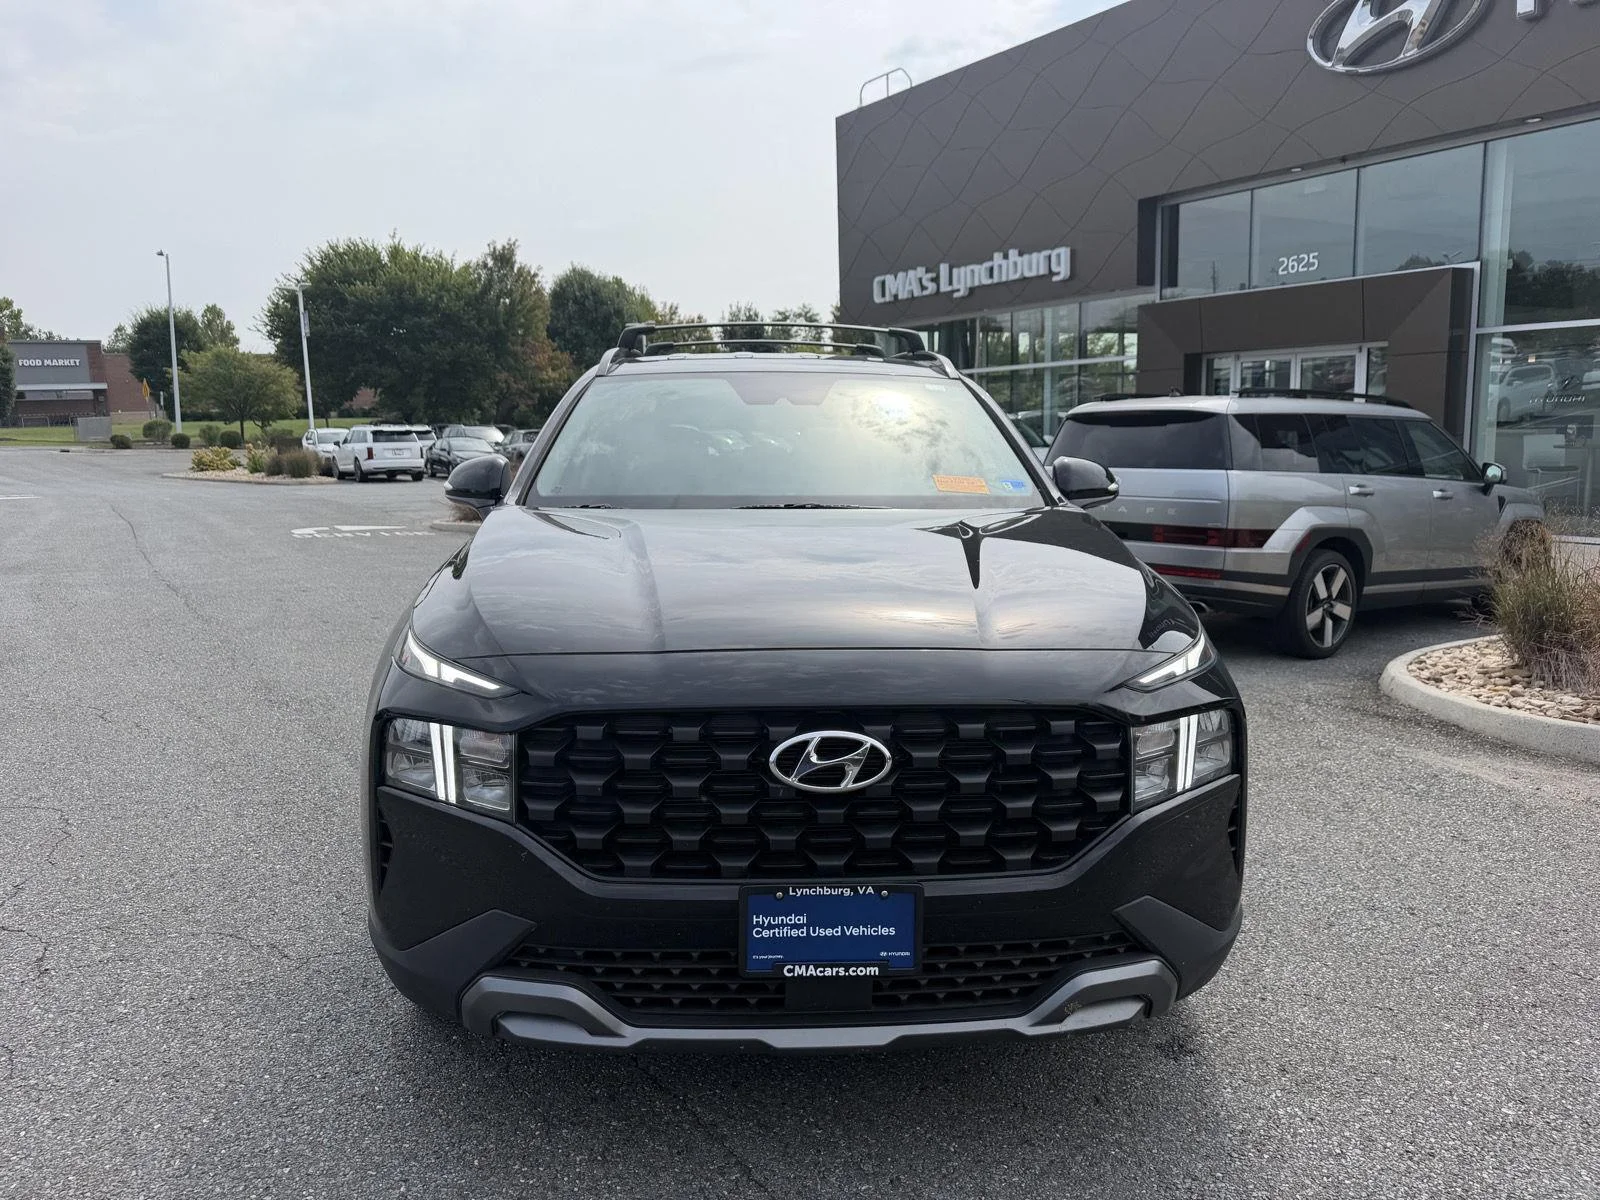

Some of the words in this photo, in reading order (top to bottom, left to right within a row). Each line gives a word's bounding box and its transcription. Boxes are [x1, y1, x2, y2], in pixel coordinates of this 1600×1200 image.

[1278, 252, 1319, 275] 2625
[873, 266, 937, 304] CMA's
[939, 246, 1071, 298] Lynchburg
[18, 359, 42, 367] FOOD
[44, 359, 81, 367] MARKET
[789, 886, 854, 897] Lynchburg,
[858, 886, 875, 895] VA
[752, 913, 807, 927] Hyundai
[752, 926, 807, 938] Certified
[809, 925, 842, 937] Used
[843, 925, 896, 936] Vehicles
[783, 964, 879, 977] CMAcars.com
